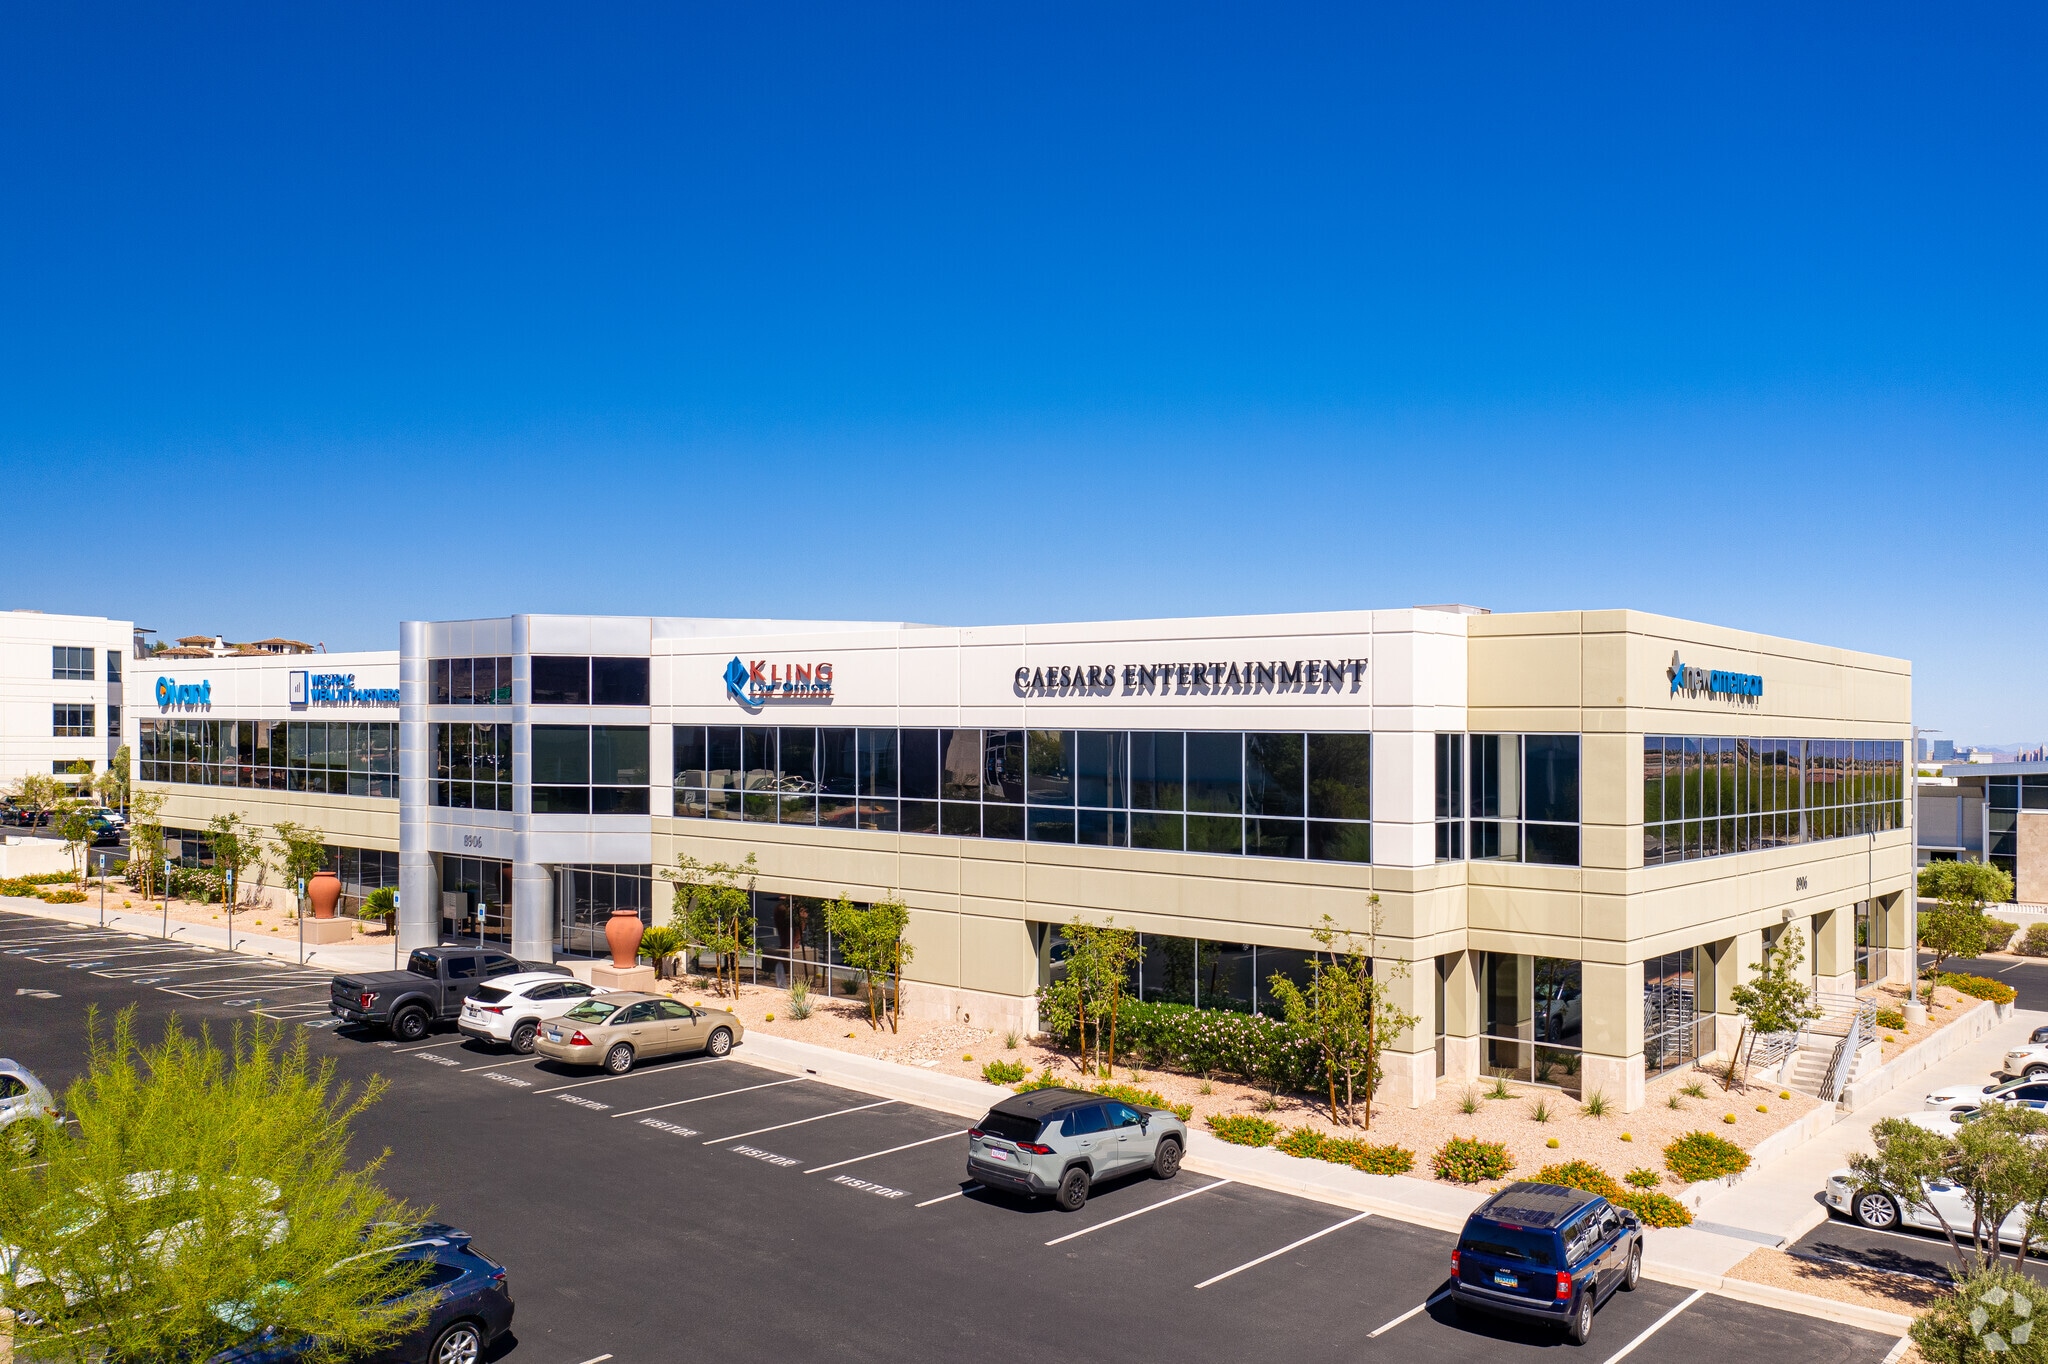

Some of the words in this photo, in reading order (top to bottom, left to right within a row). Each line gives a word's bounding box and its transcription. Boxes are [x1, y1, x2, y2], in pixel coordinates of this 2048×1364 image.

[750, 660, 833, 681] KLING
[1014, 664, 1116, 689] CAESARS
[1122, 657, 1369, 688] ENTERTAINMENT
[482, 1071, 532, 1088] VISITOR
[555, 1093, 609, 1111] VISITOR
[638, 1117, 698, 1137] VISITOR
[732, 1144, 797, 1167] VISITOR
[833, 1174, 904, 1198] VISITOR
